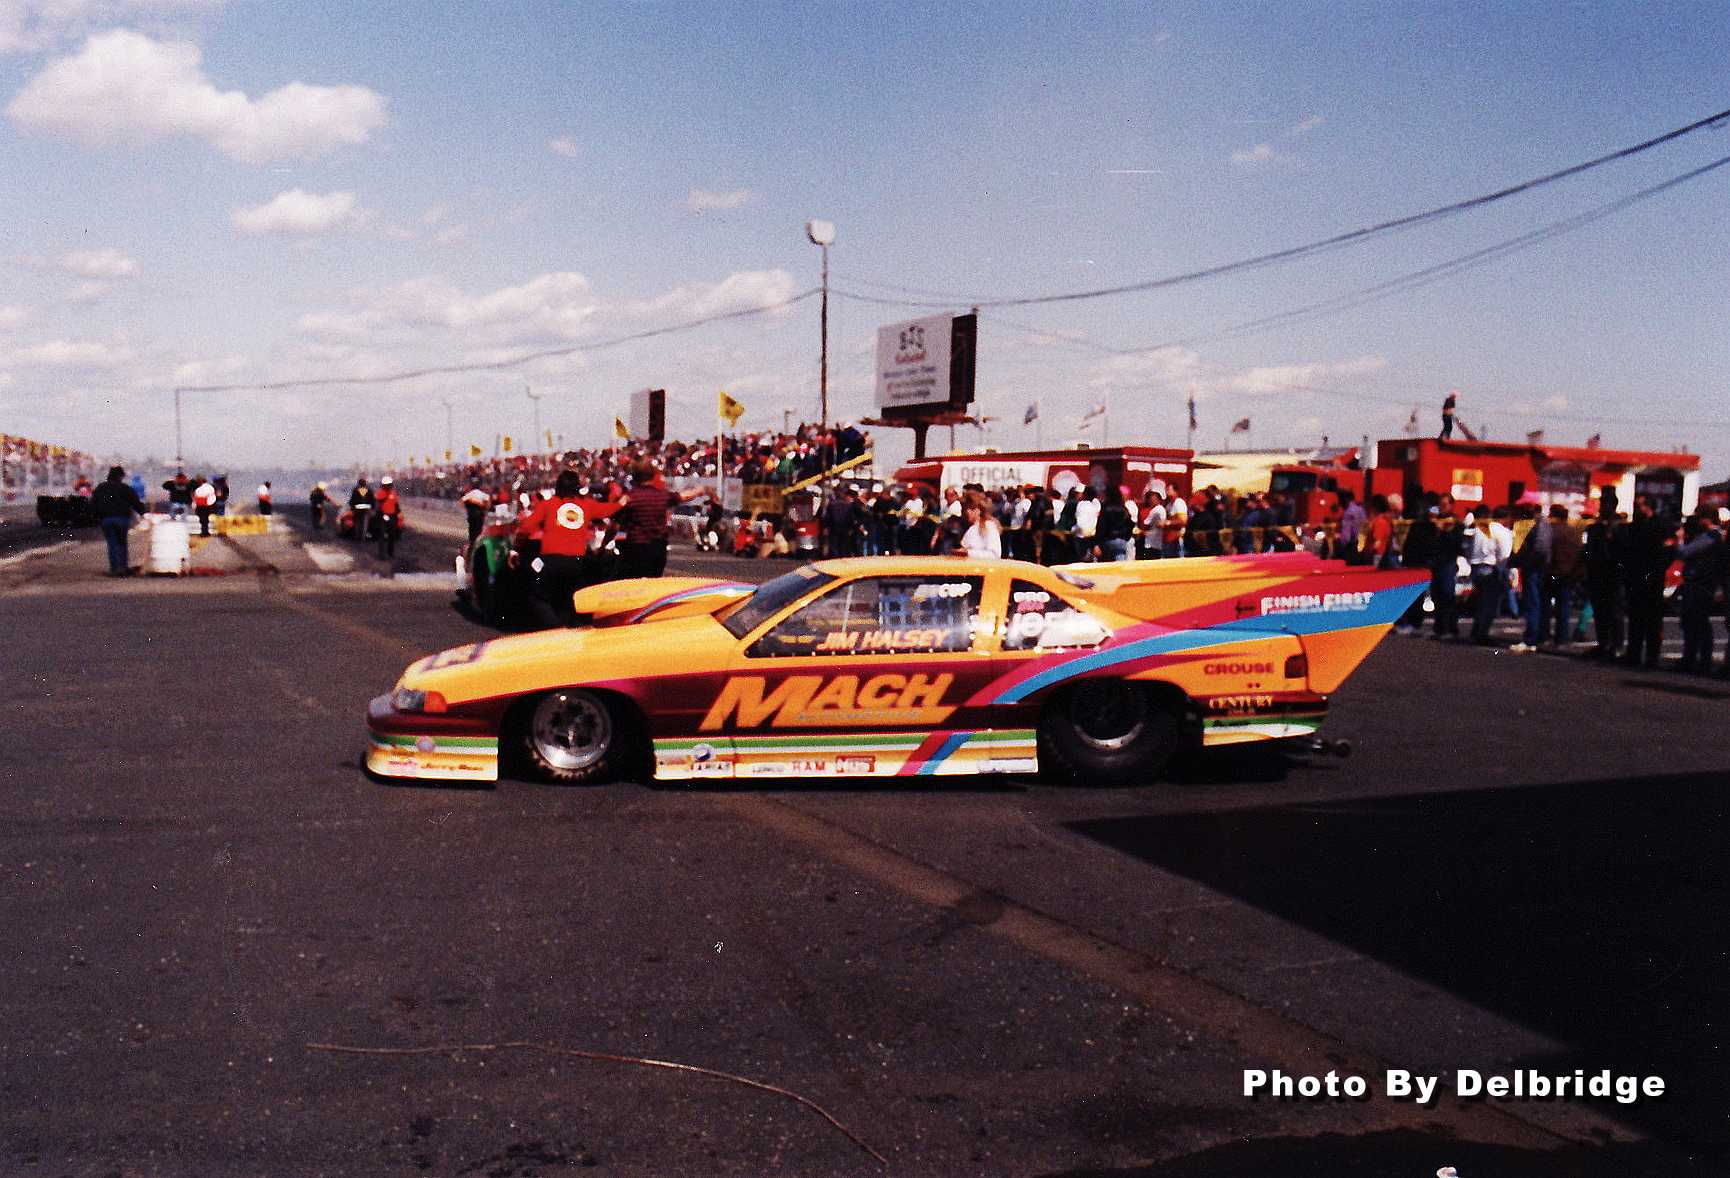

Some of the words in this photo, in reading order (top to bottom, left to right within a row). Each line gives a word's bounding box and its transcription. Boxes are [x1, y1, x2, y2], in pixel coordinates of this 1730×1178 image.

[961, 466, 1023, 481] OFFICIAL
[1260, 595, 1321, 616] FINISH
[1323, 592, 1375, 611] FIRST
[817, 631, 860, 650] JIM
[862, 629, 949, 649] HALSEY
[1204, 662, 1274, 675] CROUSE
[698, 673, 955, 730] MACH
